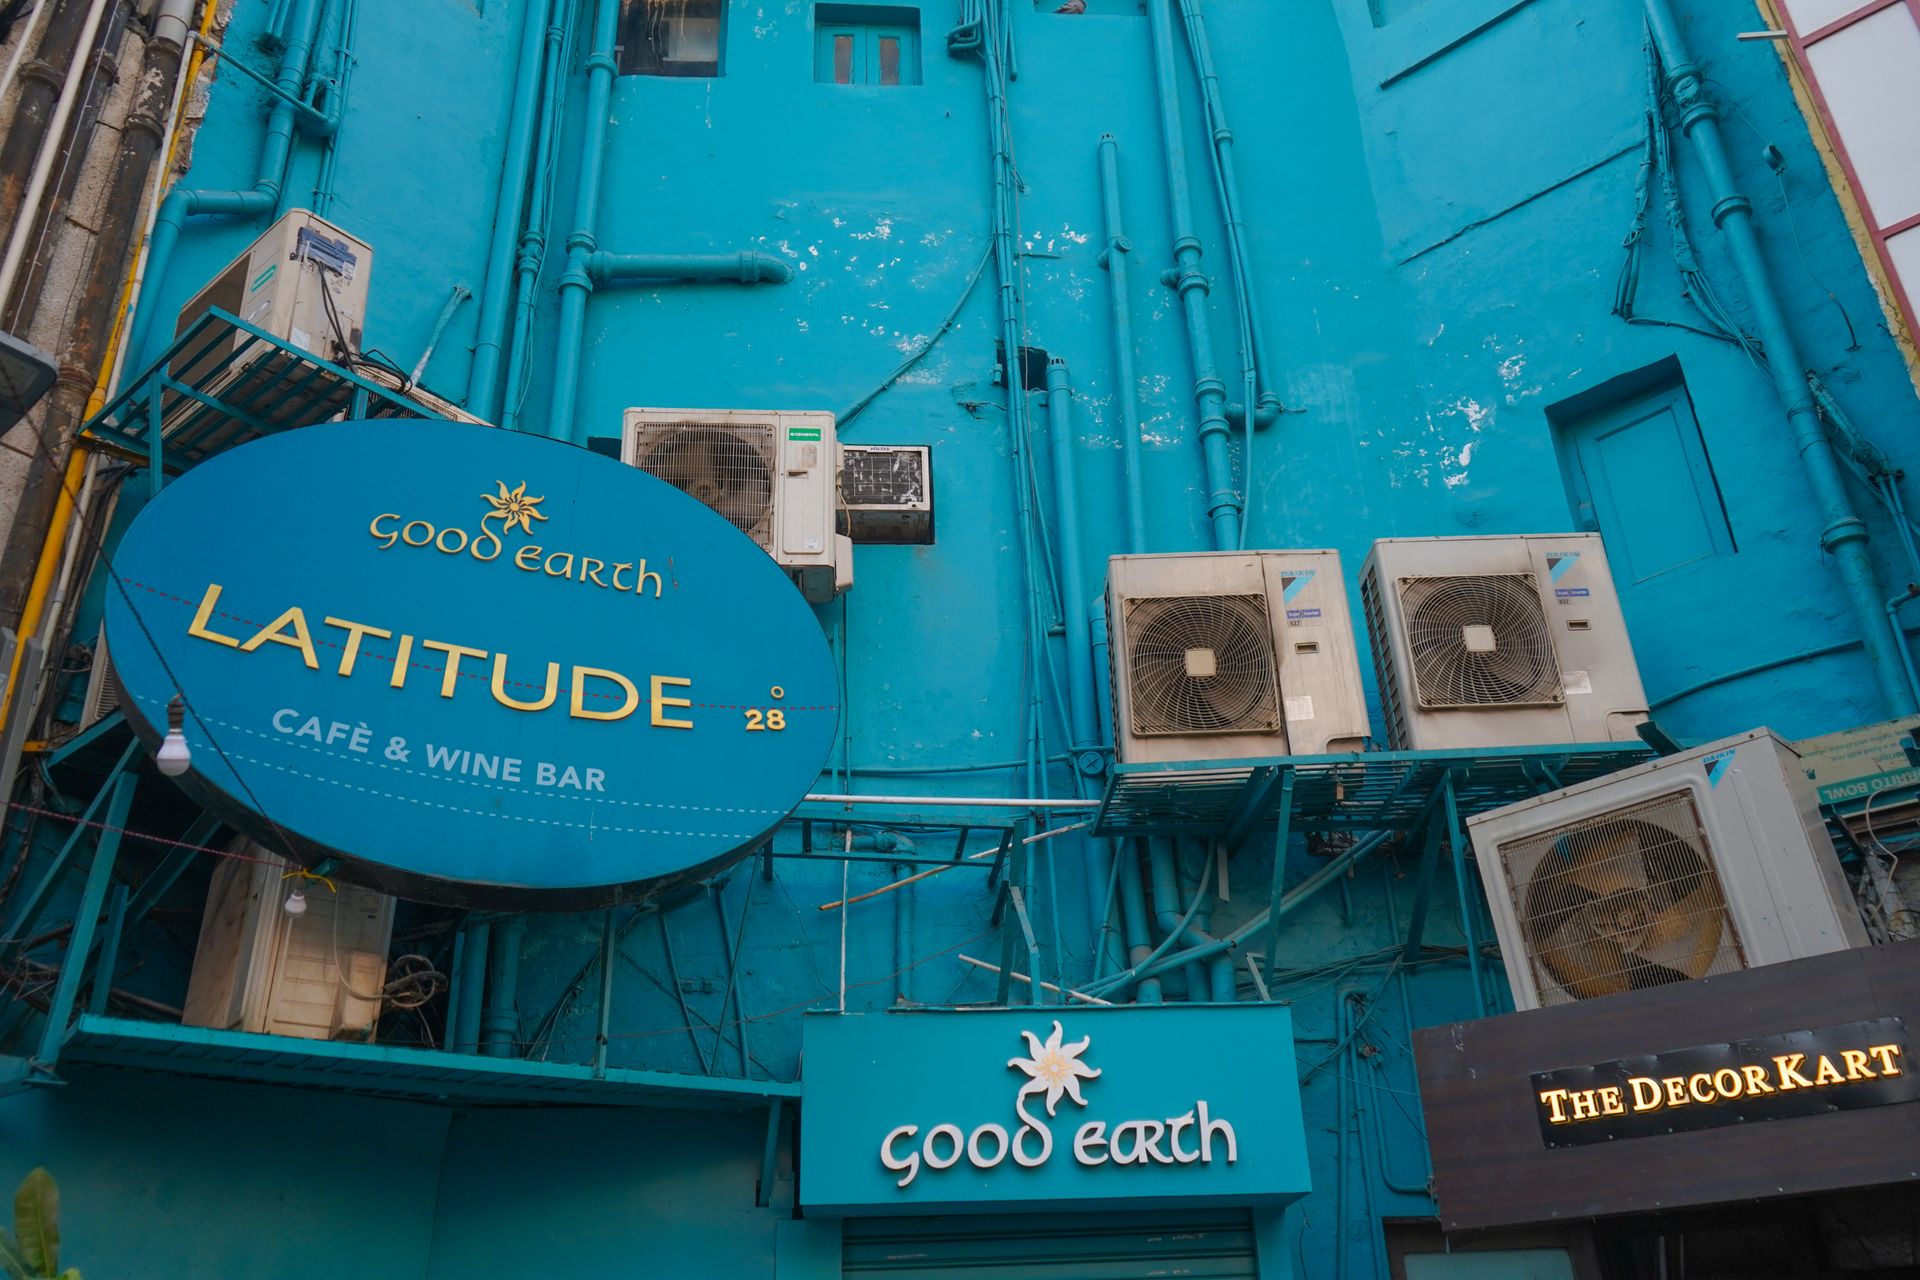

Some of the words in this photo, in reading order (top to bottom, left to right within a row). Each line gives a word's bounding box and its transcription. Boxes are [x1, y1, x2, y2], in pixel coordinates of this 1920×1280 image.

[188, 583, 694, 729] LATITUDE
[272, 708, 373, 753] CAFÈ
[384, 736, 412, 763] &
[425, 743, 523, 783] WINE
[536, 762, 606, 792] BAR
[1703, 748, 1736, 763] DAIKIN
[1823, 782, 1869, 800] BOWL
